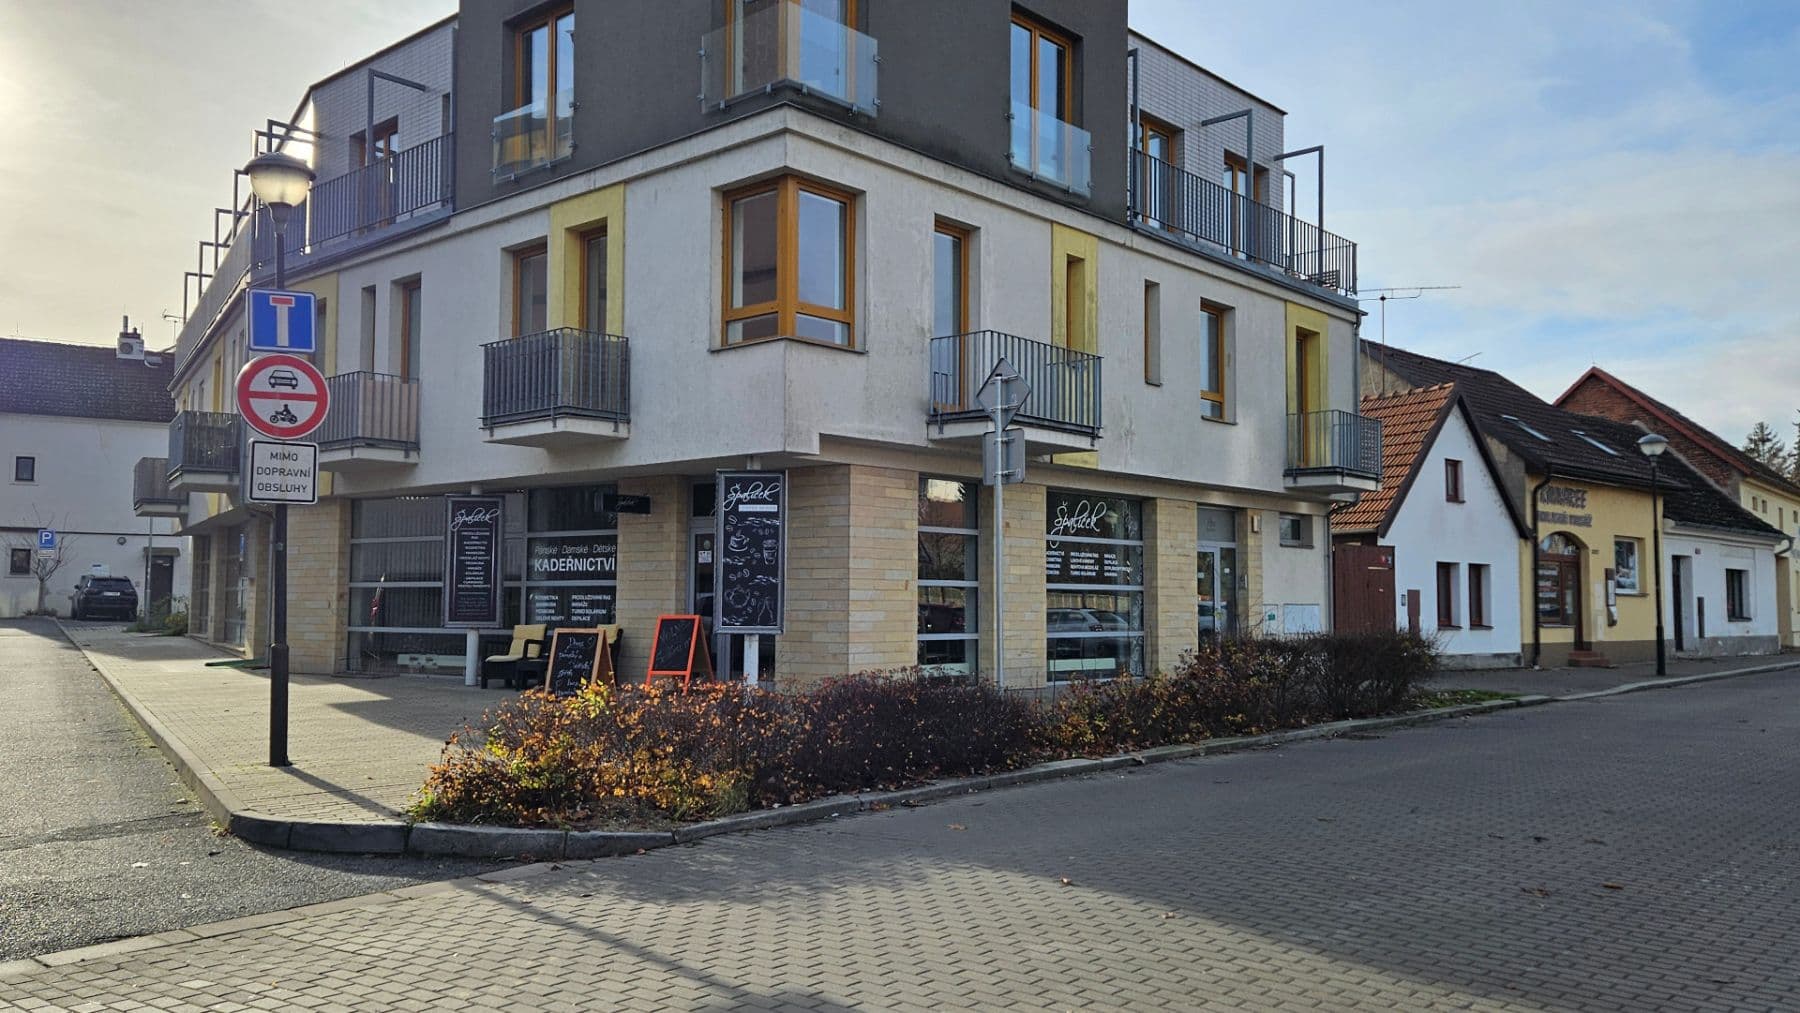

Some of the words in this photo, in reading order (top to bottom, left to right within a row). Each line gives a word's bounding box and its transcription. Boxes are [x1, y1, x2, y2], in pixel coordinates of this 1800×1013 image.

[270, 452, 298, 462] MIMO
[257, 466, 311, 478] DOPRAVNÍ
[257, 482, 308, 493] OBSLUHY
[42, 532, 52, 544] P
[534, 555, 615, 572] KADEŘNICTVÍ
